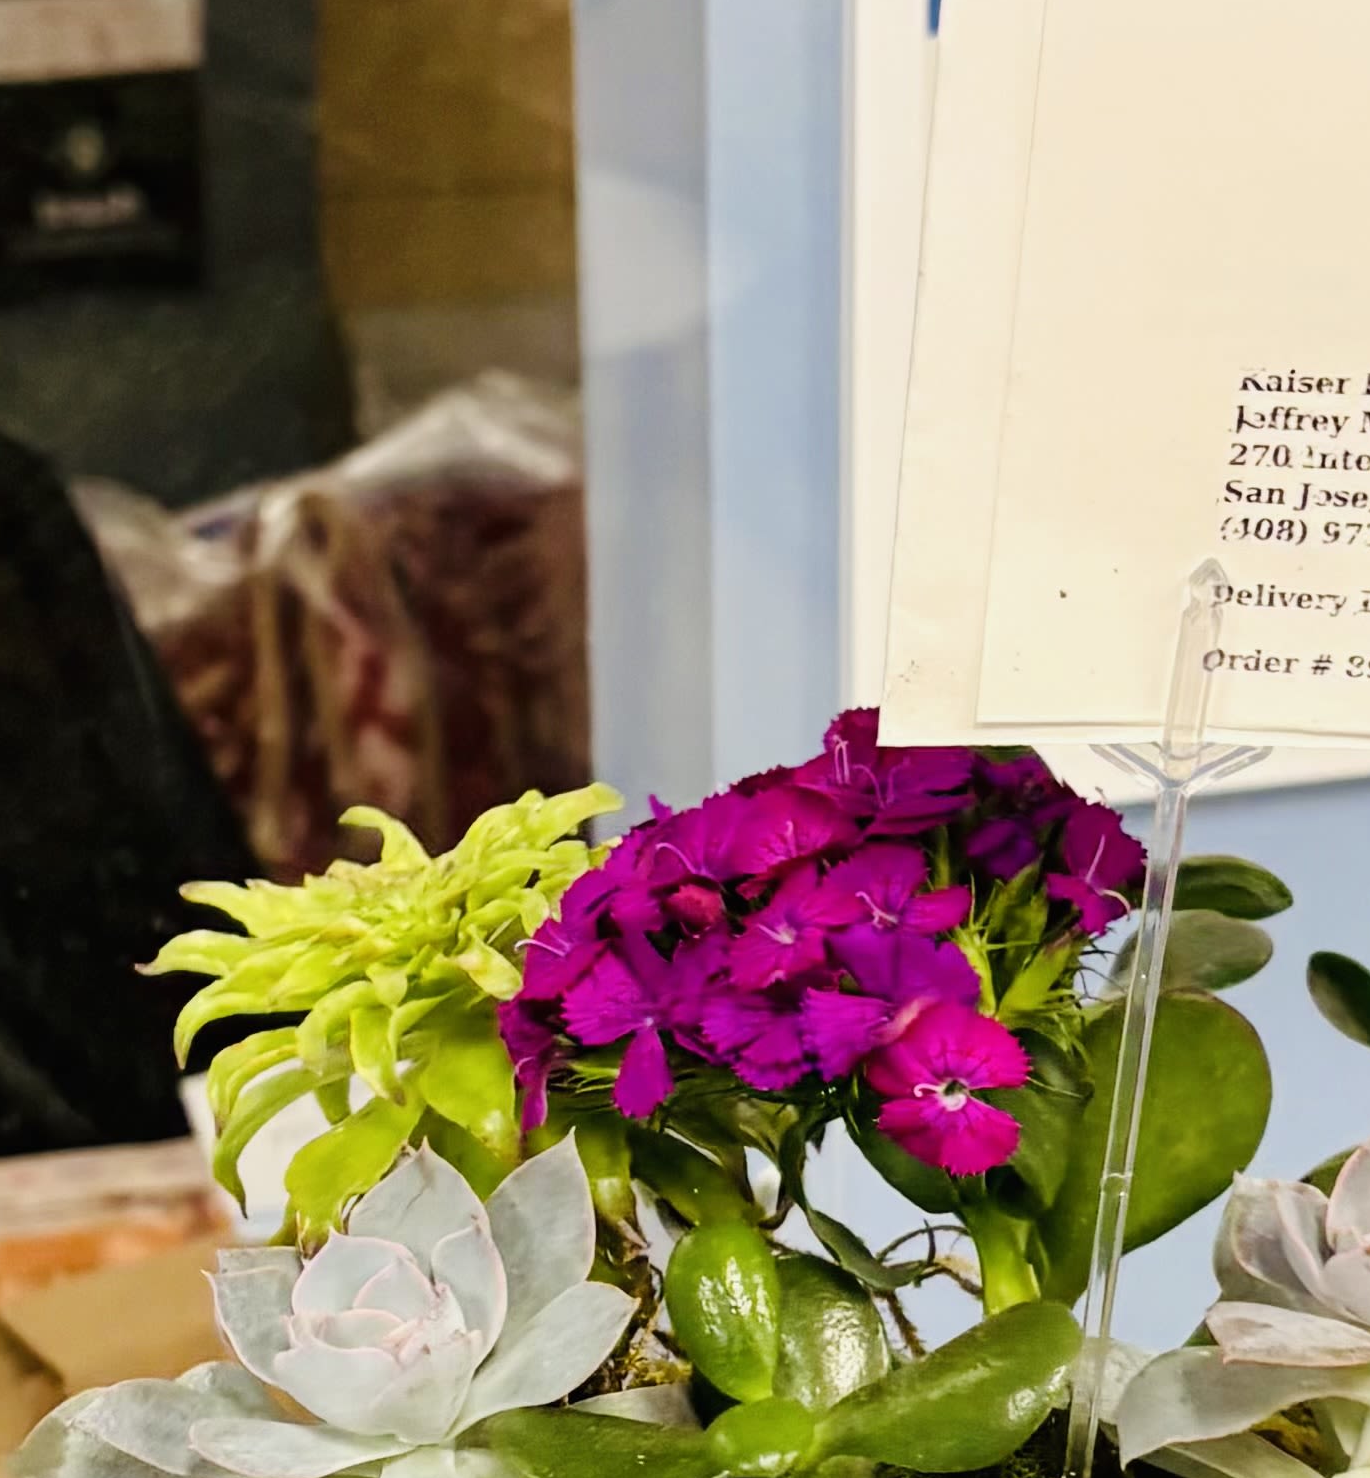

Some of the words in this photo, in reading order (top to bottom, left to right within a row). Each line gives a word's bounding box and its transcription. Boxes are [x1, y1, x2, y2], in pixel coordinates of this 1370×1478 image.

[1239, 369, 1351, 396] Kaiser
[1233, 404, 1351, 439] Jeffrey
[1228, 442, 1293, 469] 270
[1223, 480, 1286, 506] San
[1220, 516, 1309, 544] (408)
[1209, 583, 1348, 618] Delivery
[1202, 647, 1300, 674] Order
[1311, 653, 1332, 675] #
